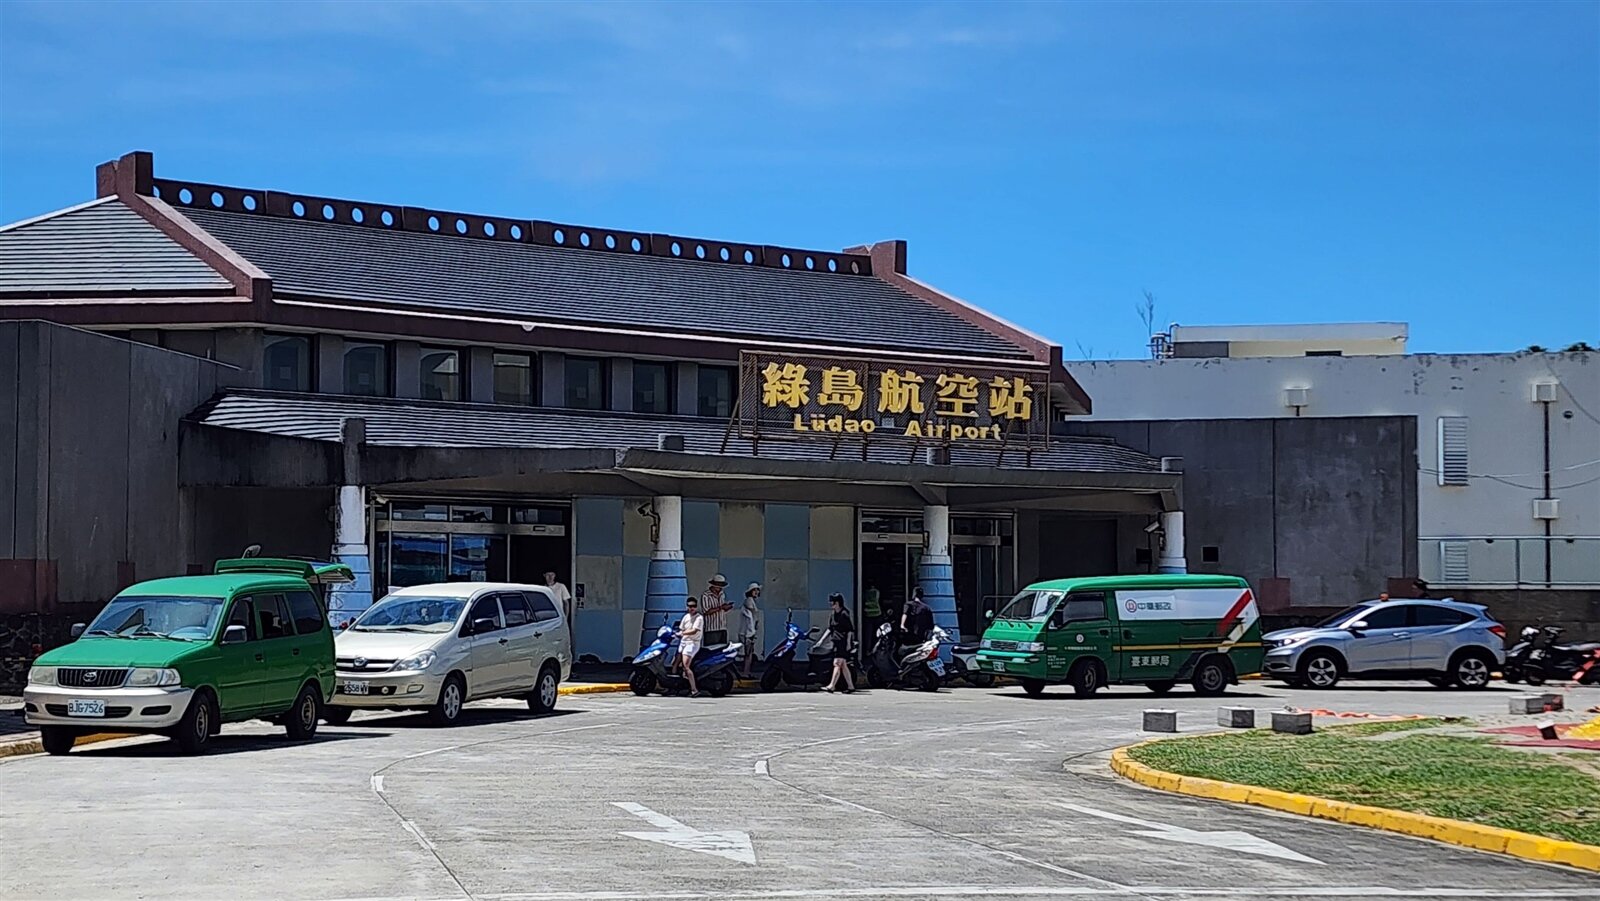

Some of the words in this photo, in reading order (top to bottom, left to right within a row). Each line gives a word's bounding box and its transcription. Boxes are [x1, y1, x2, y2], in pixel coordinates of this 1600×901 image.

[761, 362, 1032, 420] 綠島航空站
[793, 413, 876, 433] Lüdao
[904, 420, 1002, 441] Airport
